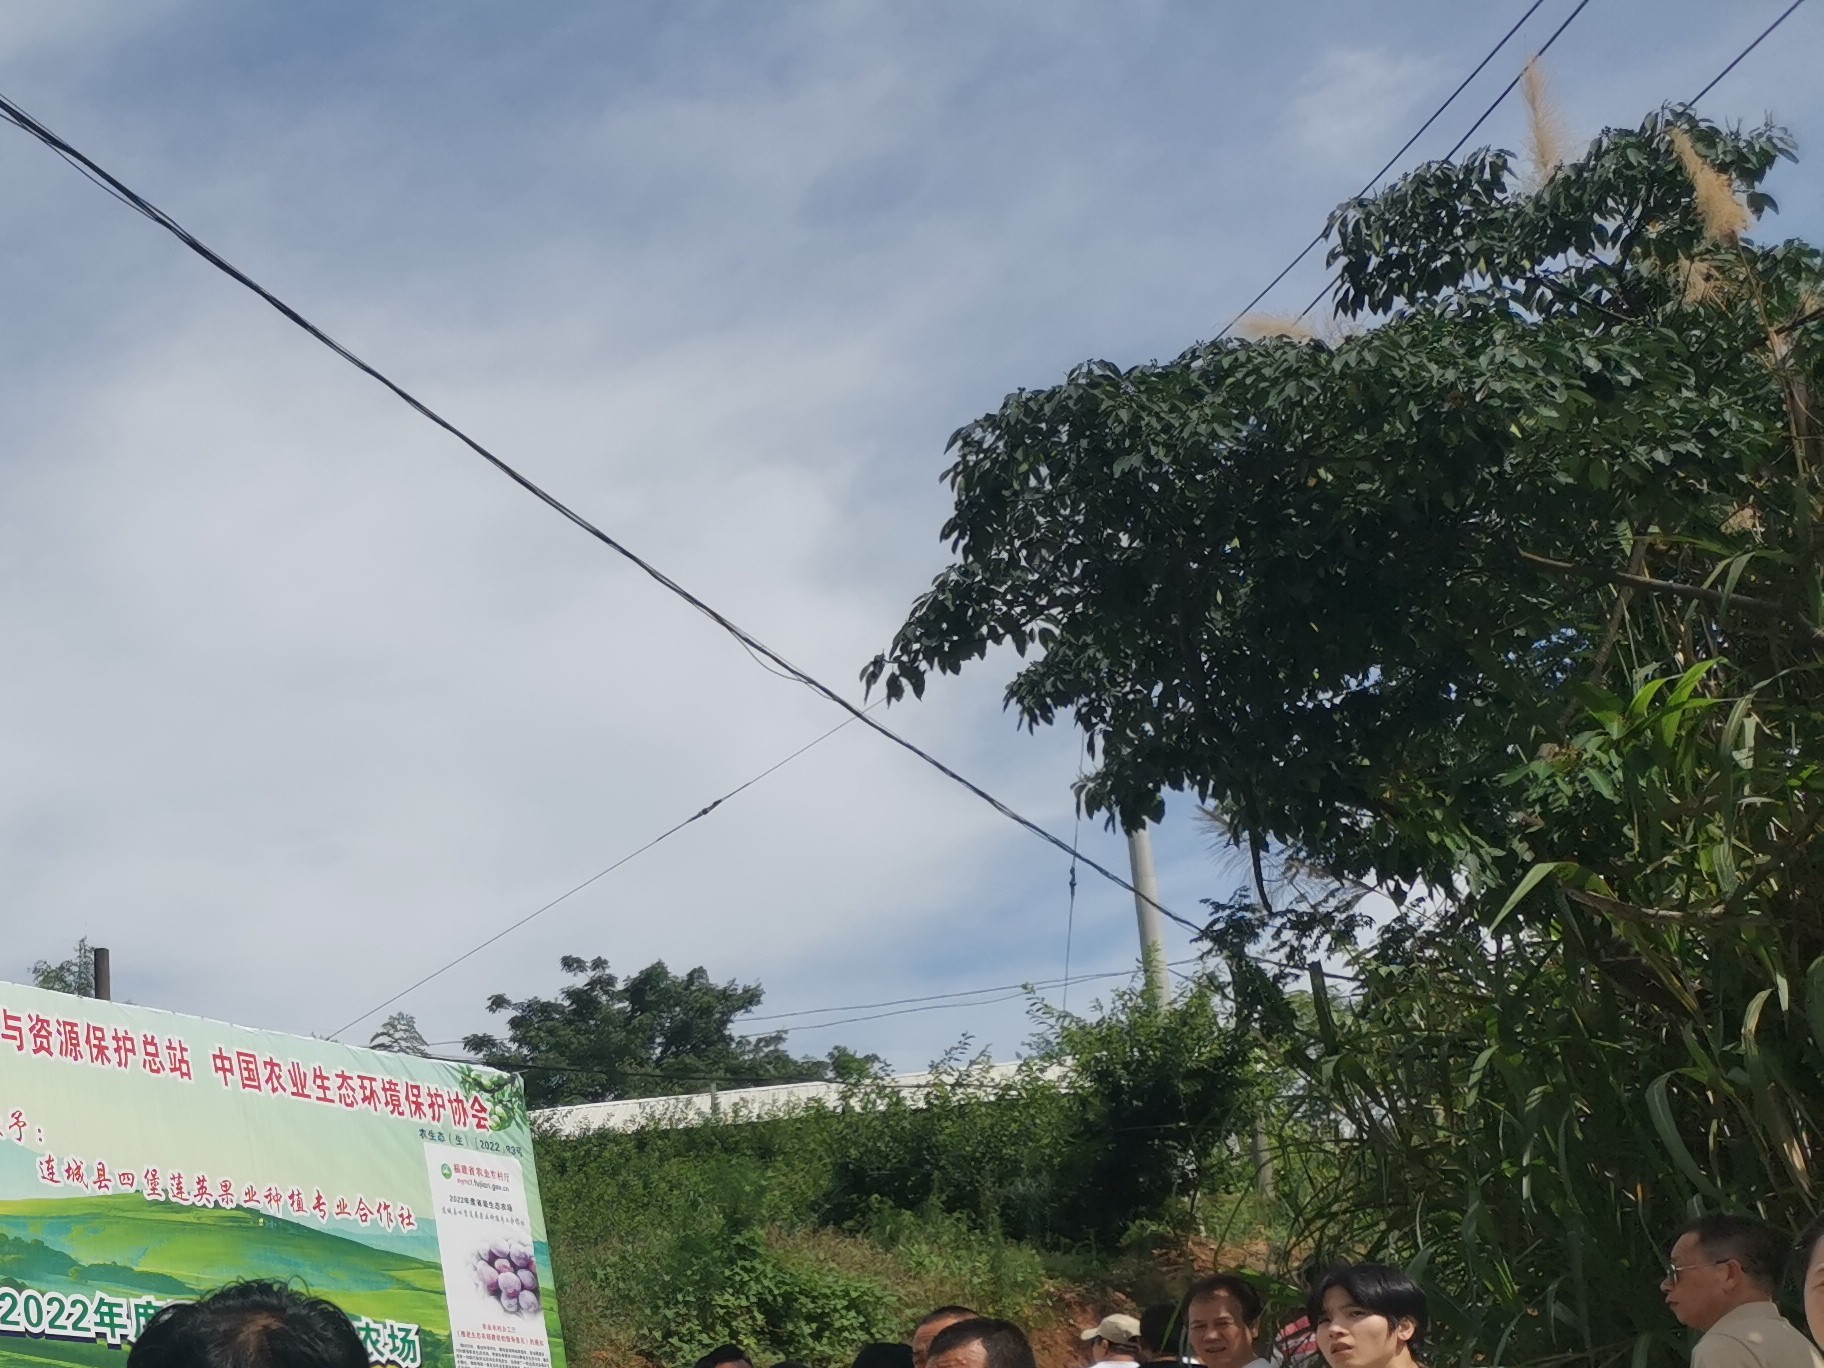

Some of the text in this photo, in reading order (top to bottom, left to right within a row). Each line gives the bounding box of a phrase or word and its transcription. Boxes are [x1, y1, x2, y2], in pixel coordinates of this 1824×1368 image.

[212, 1046, 491, 1131] 中国农业生态环境保护协会
[38, 1154, 416, 1230] 连城县四堡莲英果业种植专业合作社
